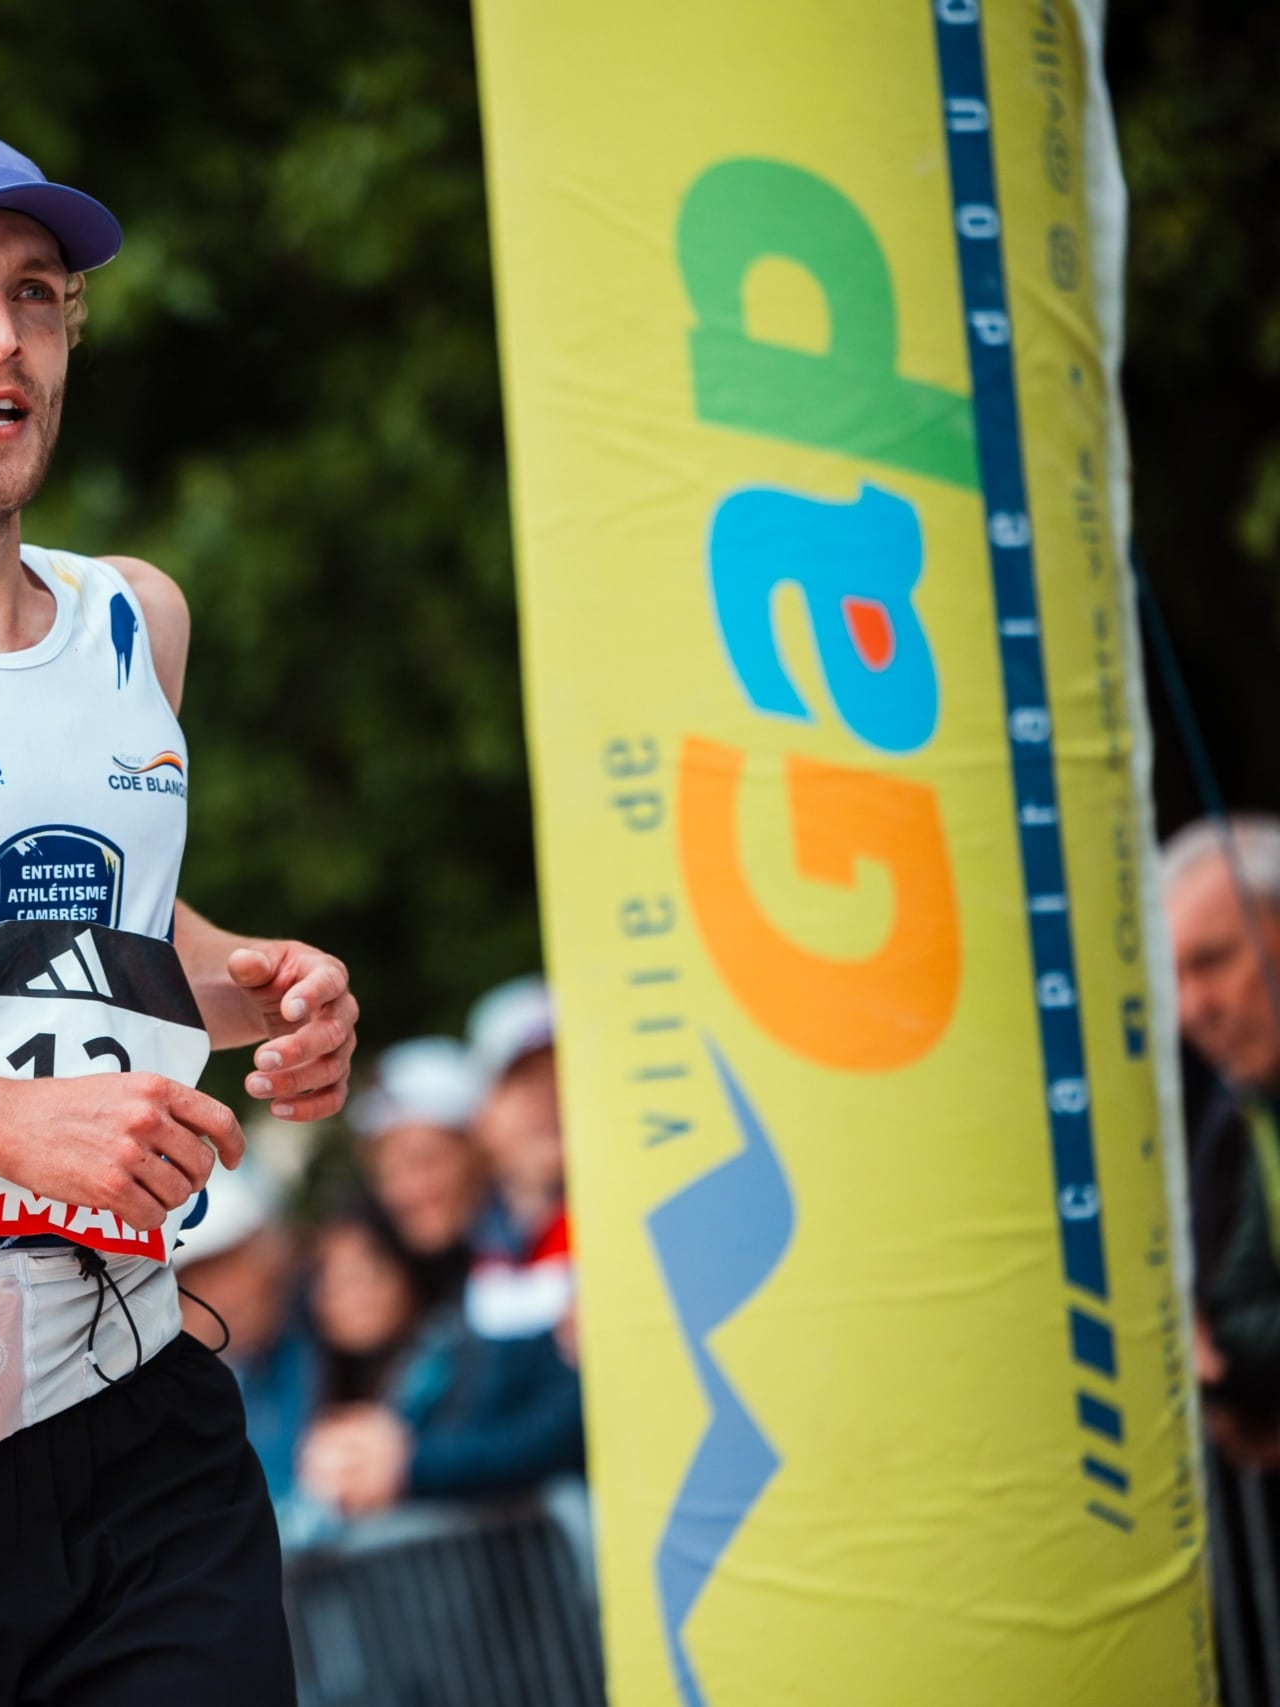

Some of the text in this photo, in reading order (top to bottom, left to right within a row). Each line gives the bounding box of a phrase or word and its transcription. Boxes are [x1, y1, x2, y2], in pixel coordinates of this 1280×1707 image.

[675, 155, 983, 1076] Gap
[108, 775, 142, 791] CDE
[21, 863, 96, 880] ENTENTE
[988, 510, 1101, 1221] capitale
[7, 883, 108, 903] ATHLÉTISME
[17, 904, 98, 920] CAMBRÉSIS
[602, 734, 694, 1149] ville de
